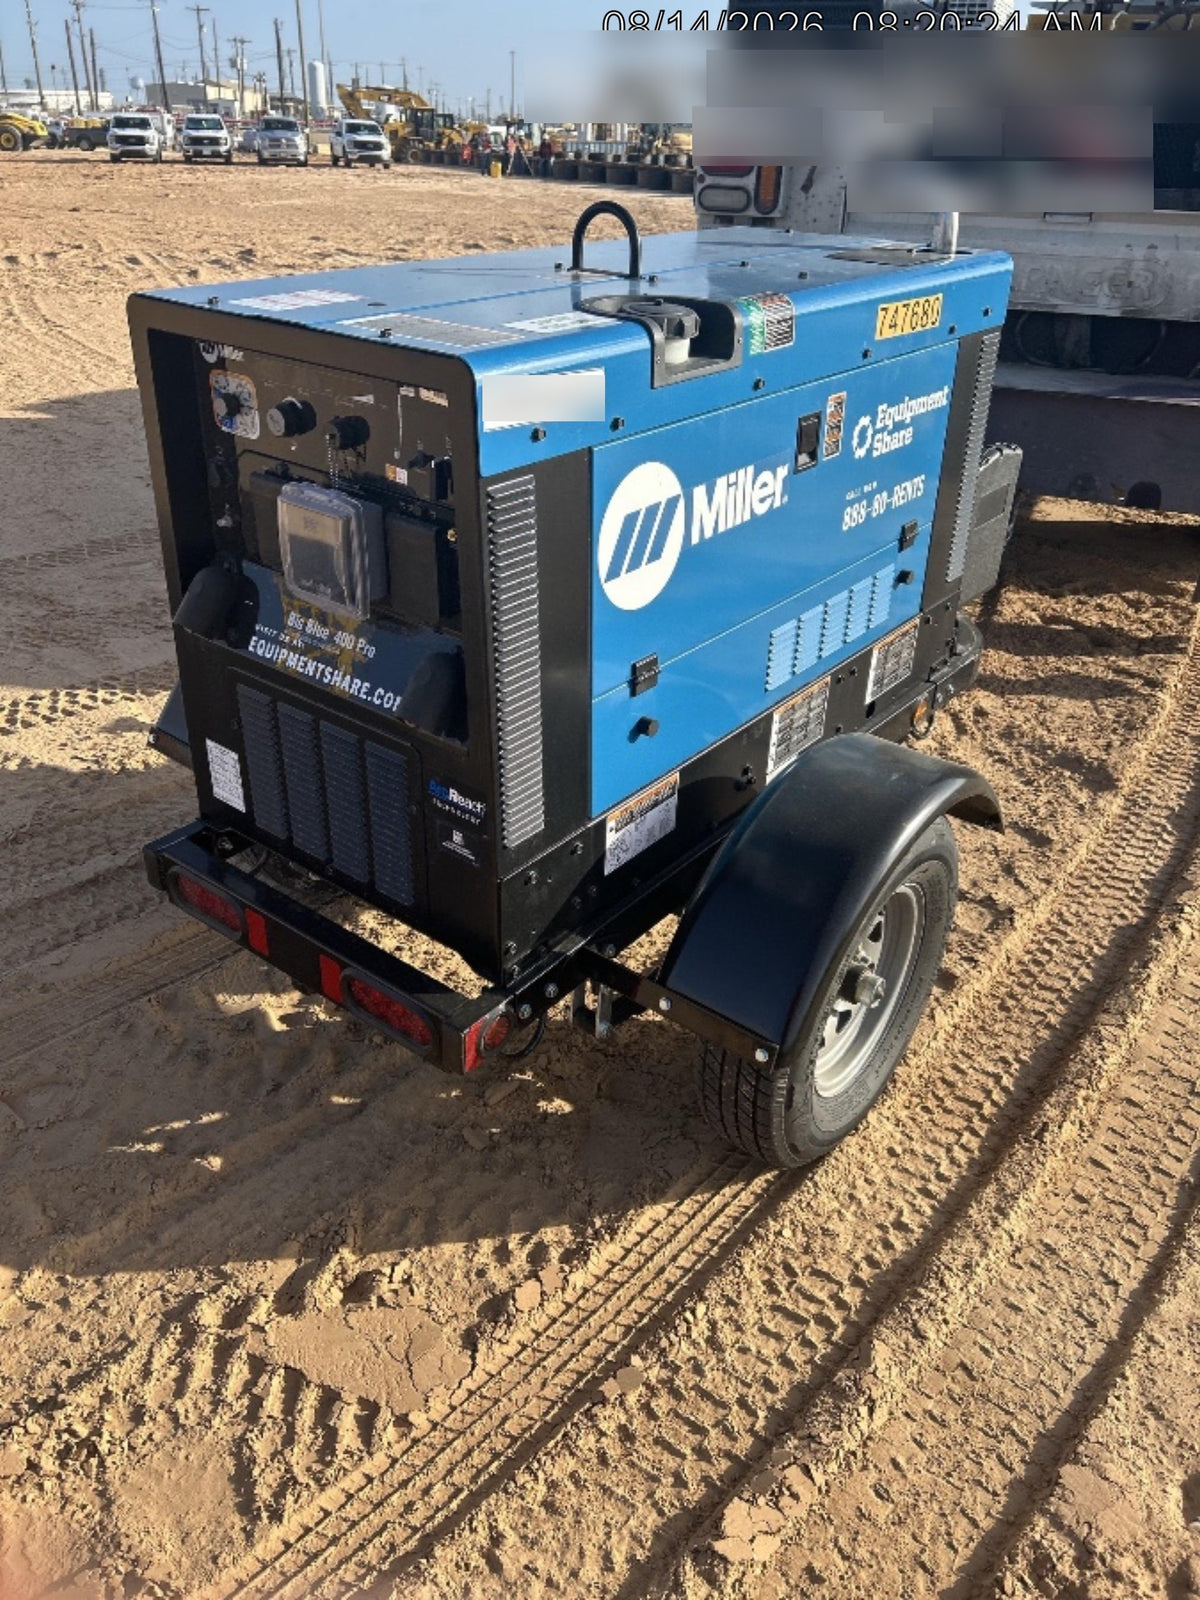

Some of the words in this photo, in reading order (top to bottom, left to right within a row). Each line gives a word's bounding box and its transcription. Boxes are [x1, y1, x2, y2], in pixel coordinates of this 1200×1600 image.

[879, 297, 940, 336] 747680
[876, 386, 949, 428] Equipment
[873, 427, 913, 457] Share
[691, 465, 789, 546] Miller
[842, 475, 925, 530] 888-80-RENTS
[333, 630, 355, 650] 400
[356, 637, 376, 659] Pro
